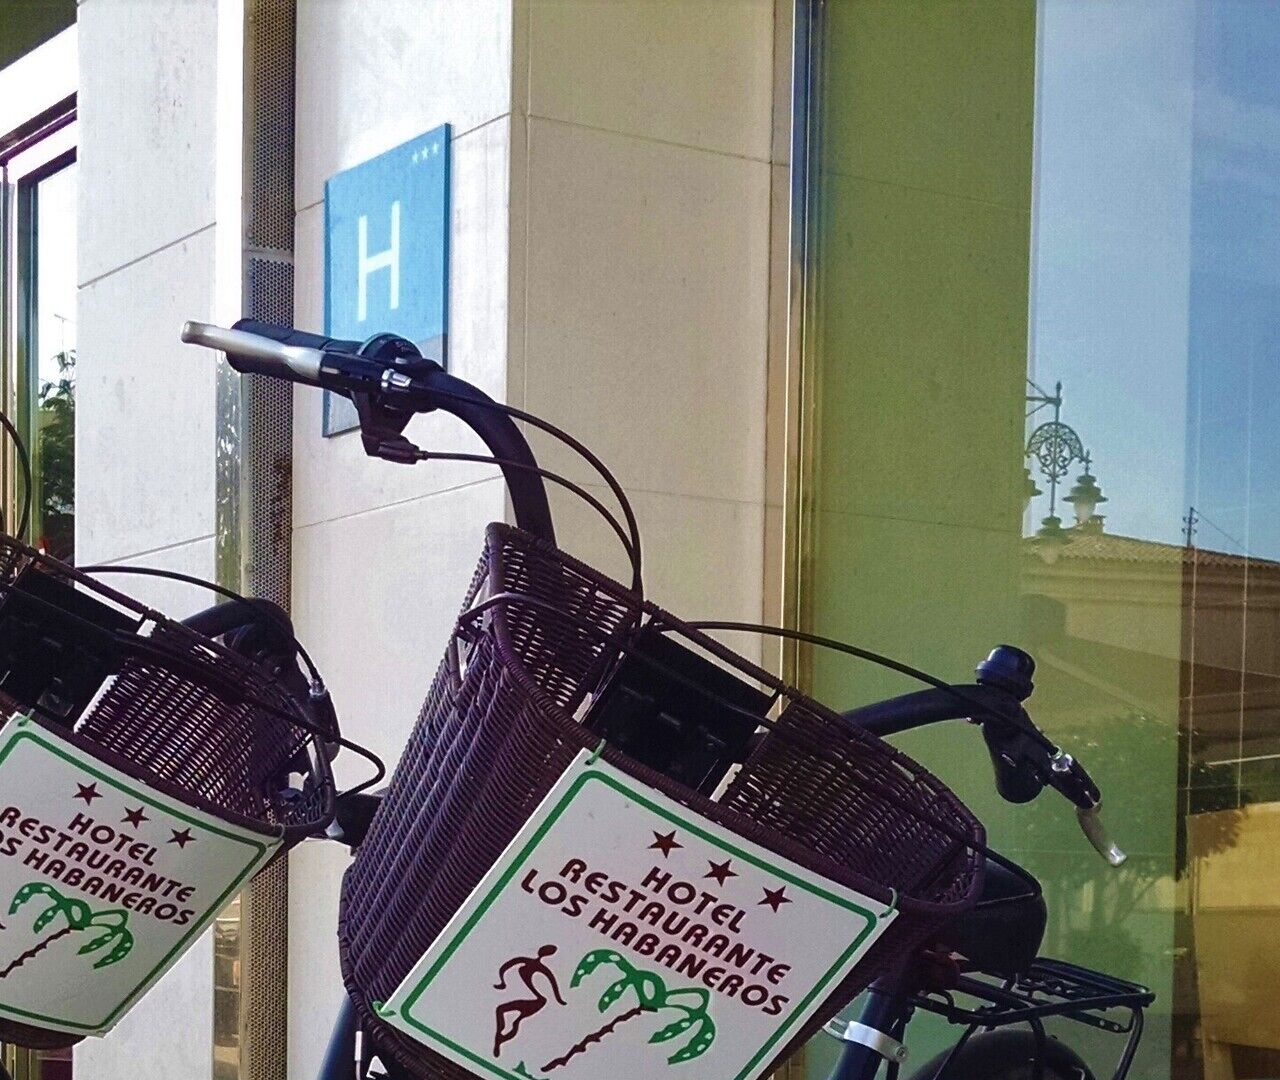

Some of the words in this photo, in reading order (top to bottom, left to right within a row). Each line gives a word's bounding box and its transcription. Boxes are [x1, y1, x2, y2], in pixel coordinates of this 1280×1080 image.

[357, 200, 401, 322] H
[68, 812, 160, 867] HOTEL
[23, 851, 196, 928] HABANEROS
[558, 857, 793, 986] RESTAURANTE
[640, 865, 749, 935] HOTEL
[520, 868, 588, 919] LOS
[588, 910, 792, 1017] HABANEROS
